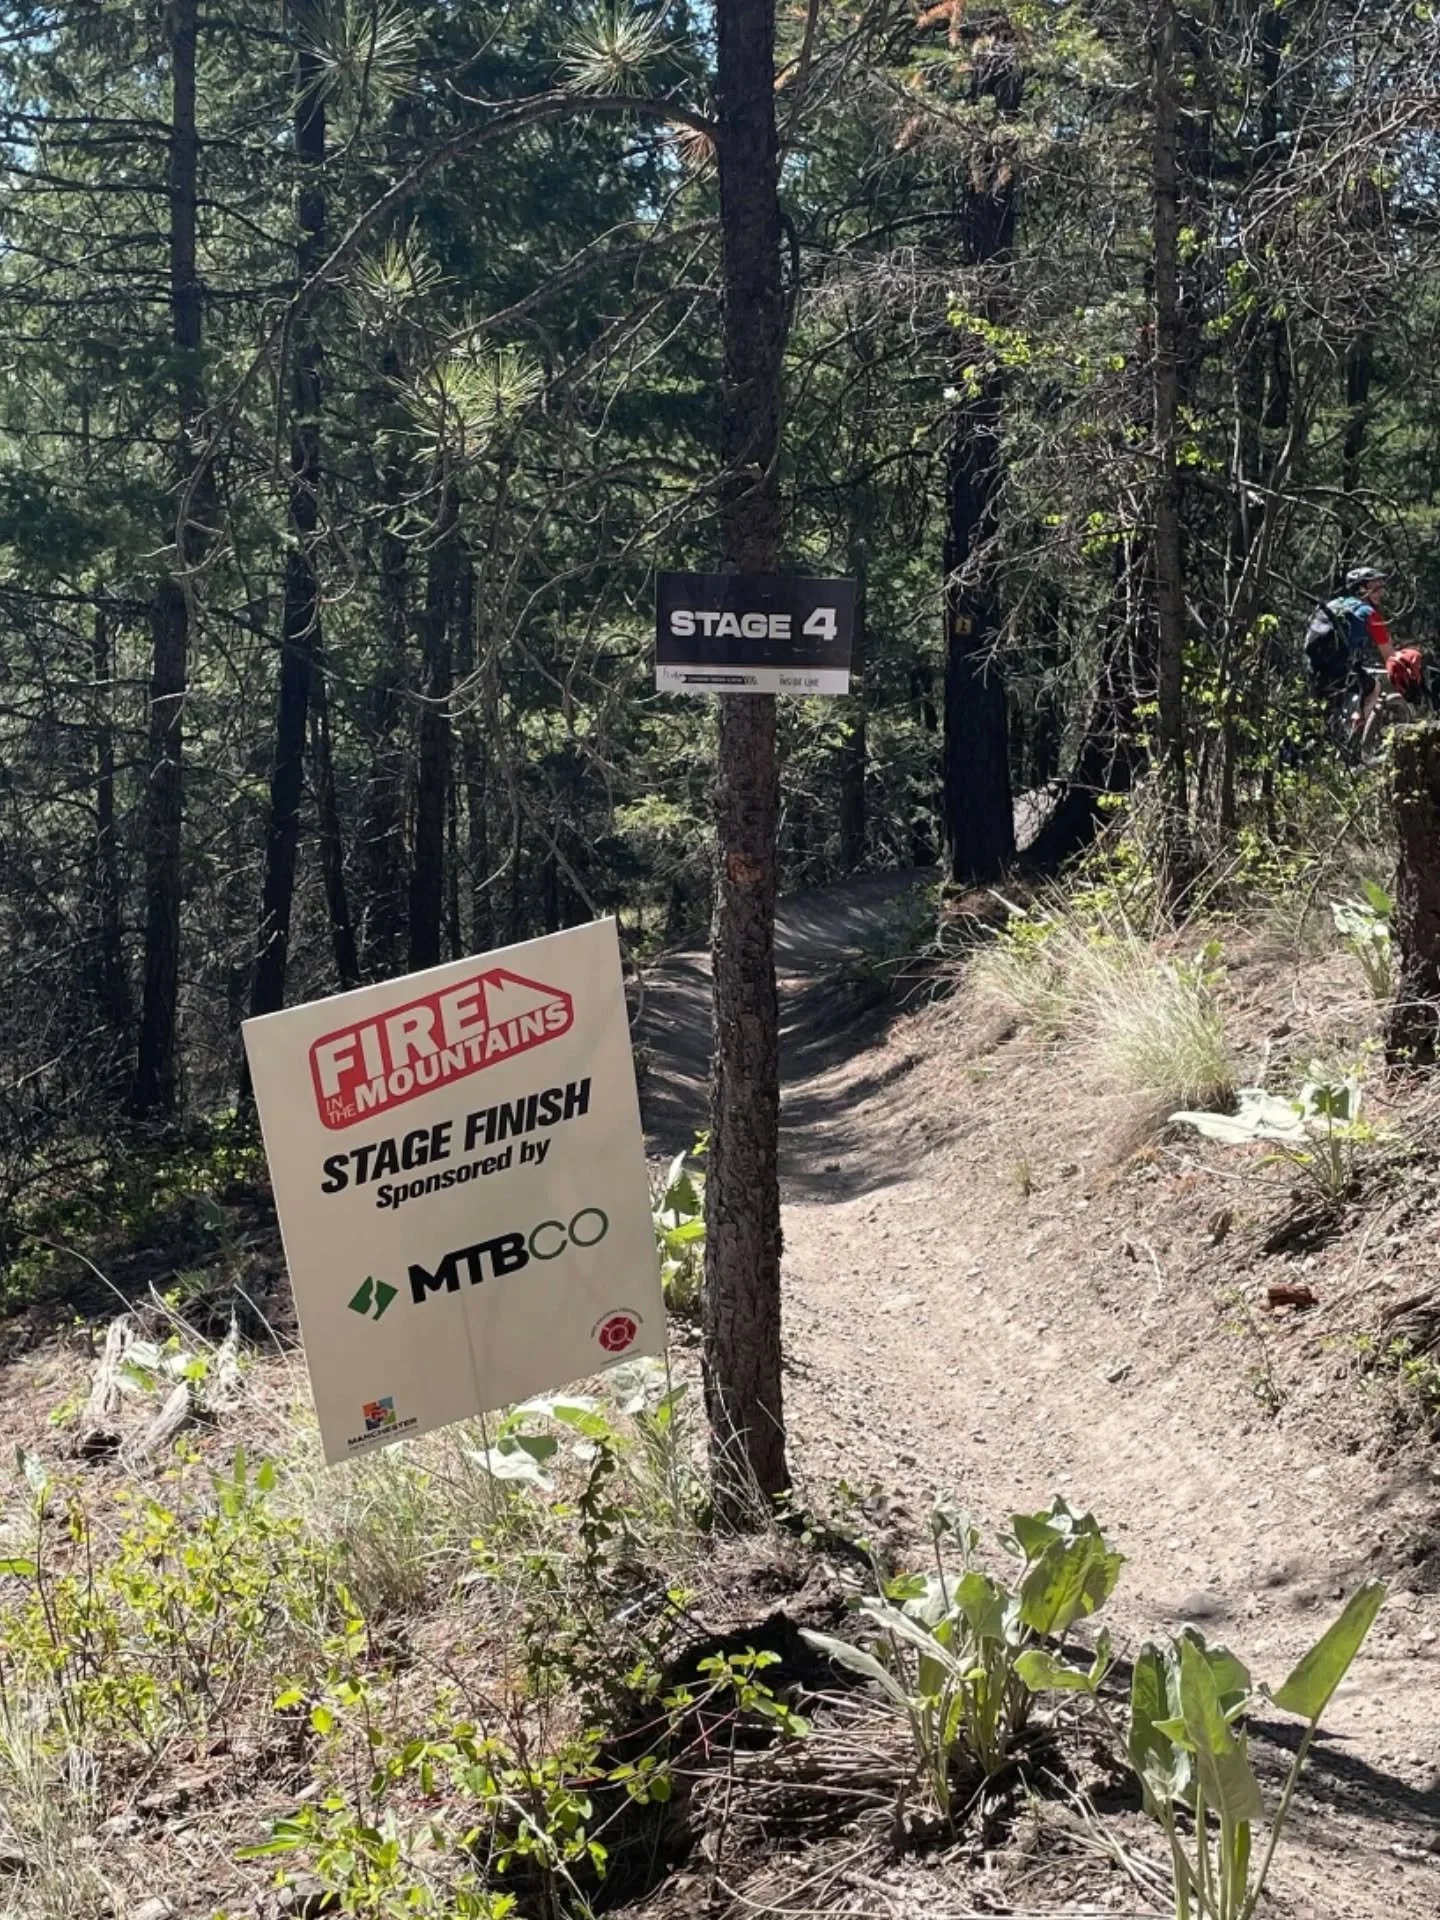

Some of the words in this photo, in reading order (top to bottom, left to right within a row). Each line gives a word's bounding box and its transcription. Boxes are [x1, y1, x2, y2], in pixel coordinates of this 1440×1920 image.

[670, 610, 792, 640] STAGE
[803, 607, 838, 641] 4
[315, 979, 486, 1098] FIRE
[328, 1103, 356, 1125] THE
[355, 1000, 569, 1113] MOUNTAINS
[321, 1120, 453, 1193] STAGE
[464, 1077, 592, 1151] FINISH
[326, 1096, 343, 1112] IN
[376, 1146, 512, 1210] Sponsored
[519, 1138, 551, 1165] by
[407, 1207, 609, 1304] MTBCO
